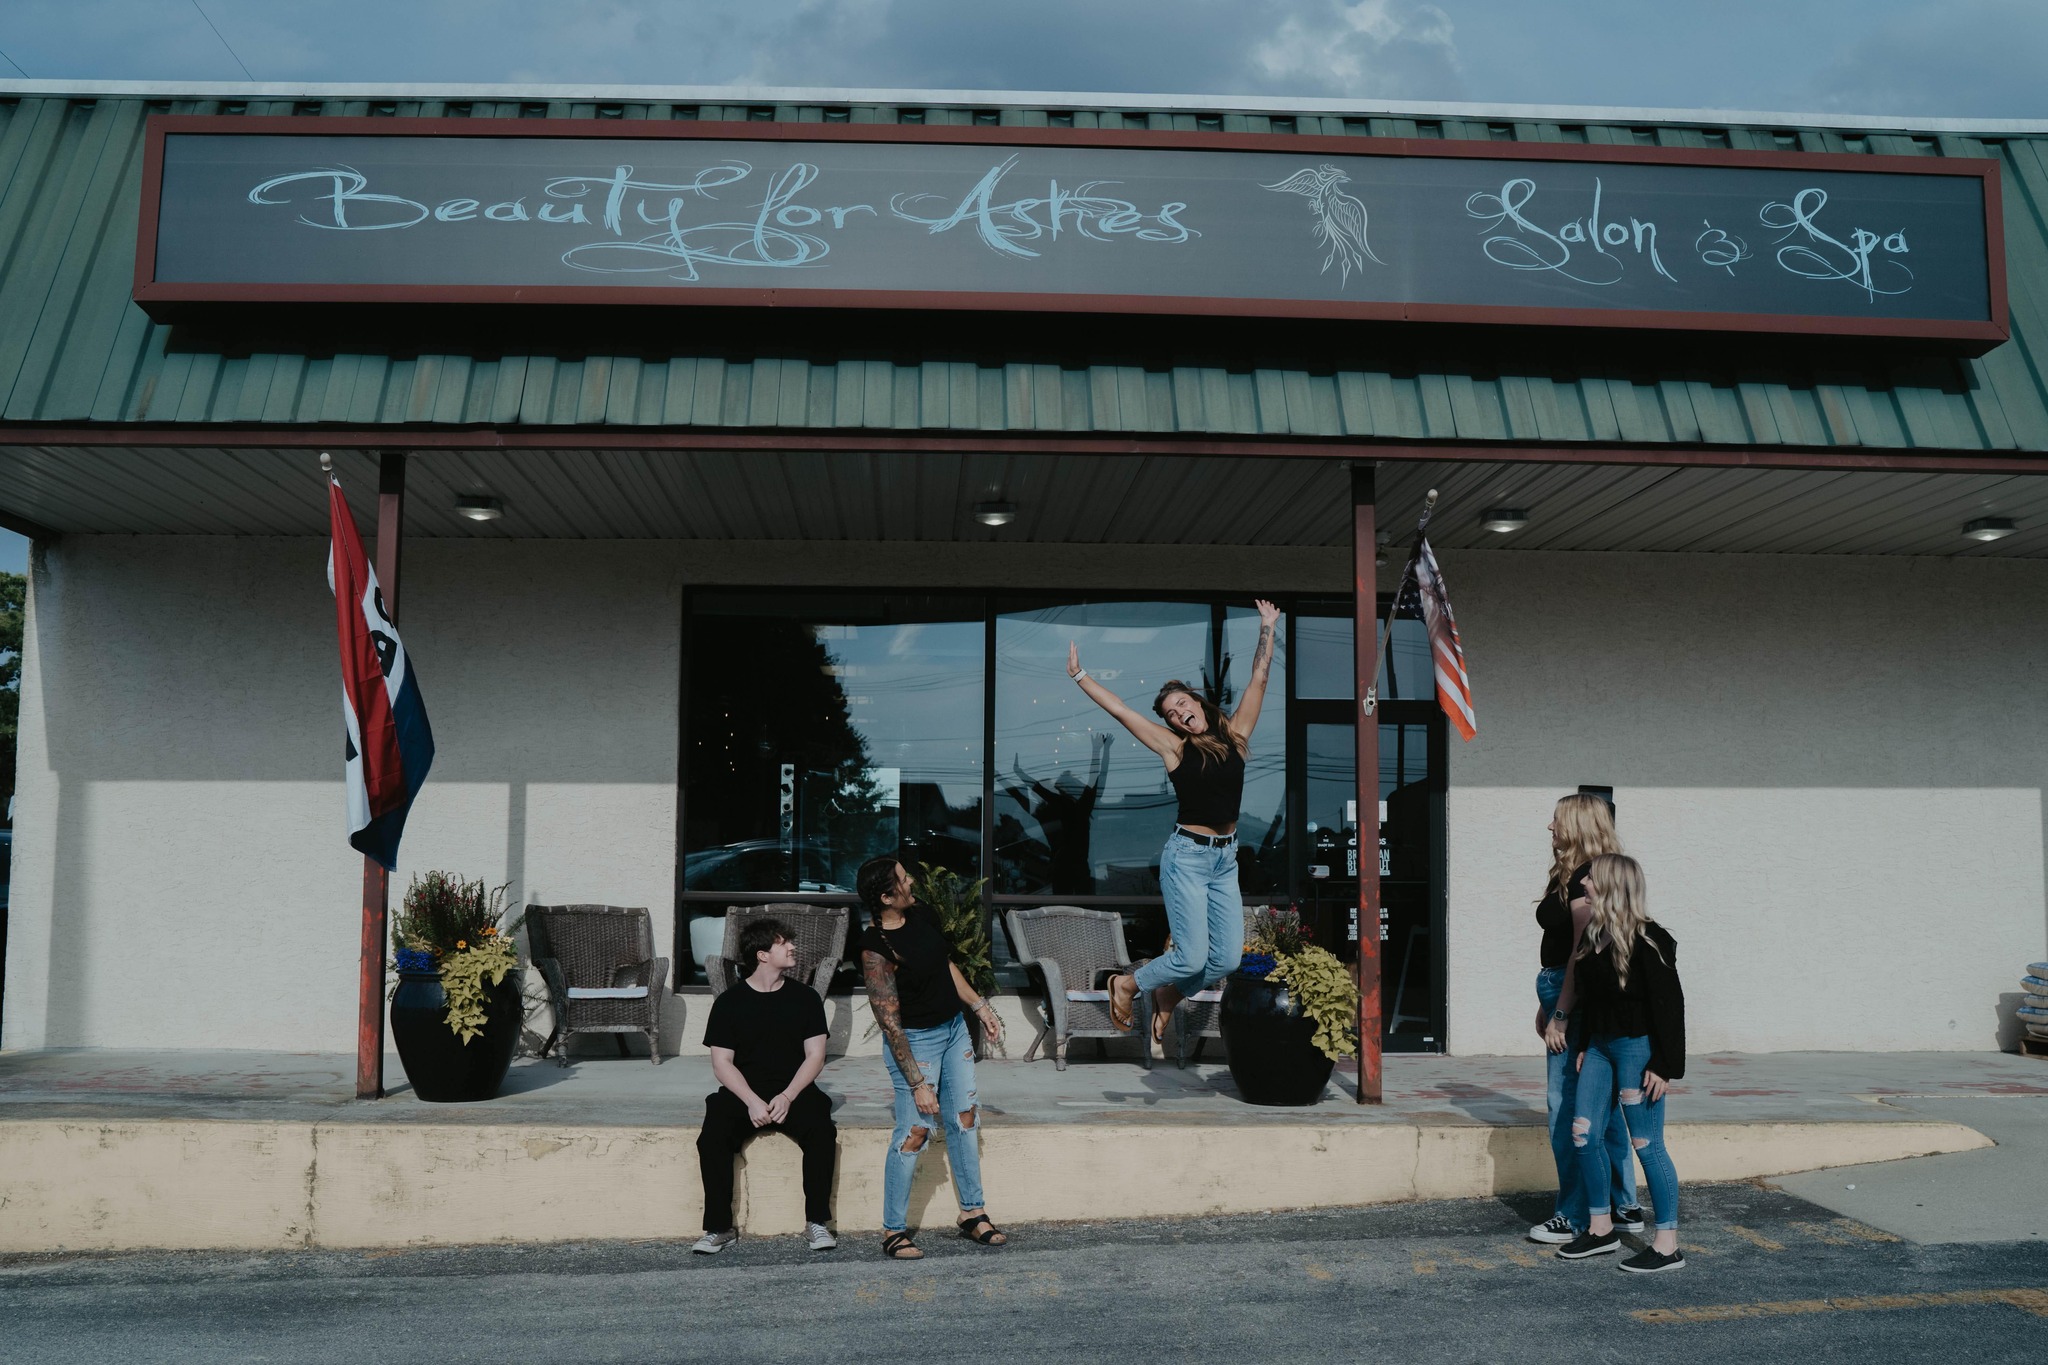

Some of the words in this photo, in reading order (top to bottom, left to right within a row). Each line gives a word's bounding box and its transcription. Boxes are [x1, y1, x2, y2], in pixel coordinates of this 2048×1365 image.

[248, 160, 752, 281] Beauty
[747, 163, 877, 267] for
[890, 152, 1202, 260] Ashes
[1465, 177, 1678, 285] Salon
[1760, 187, 1914, 303] Spa
